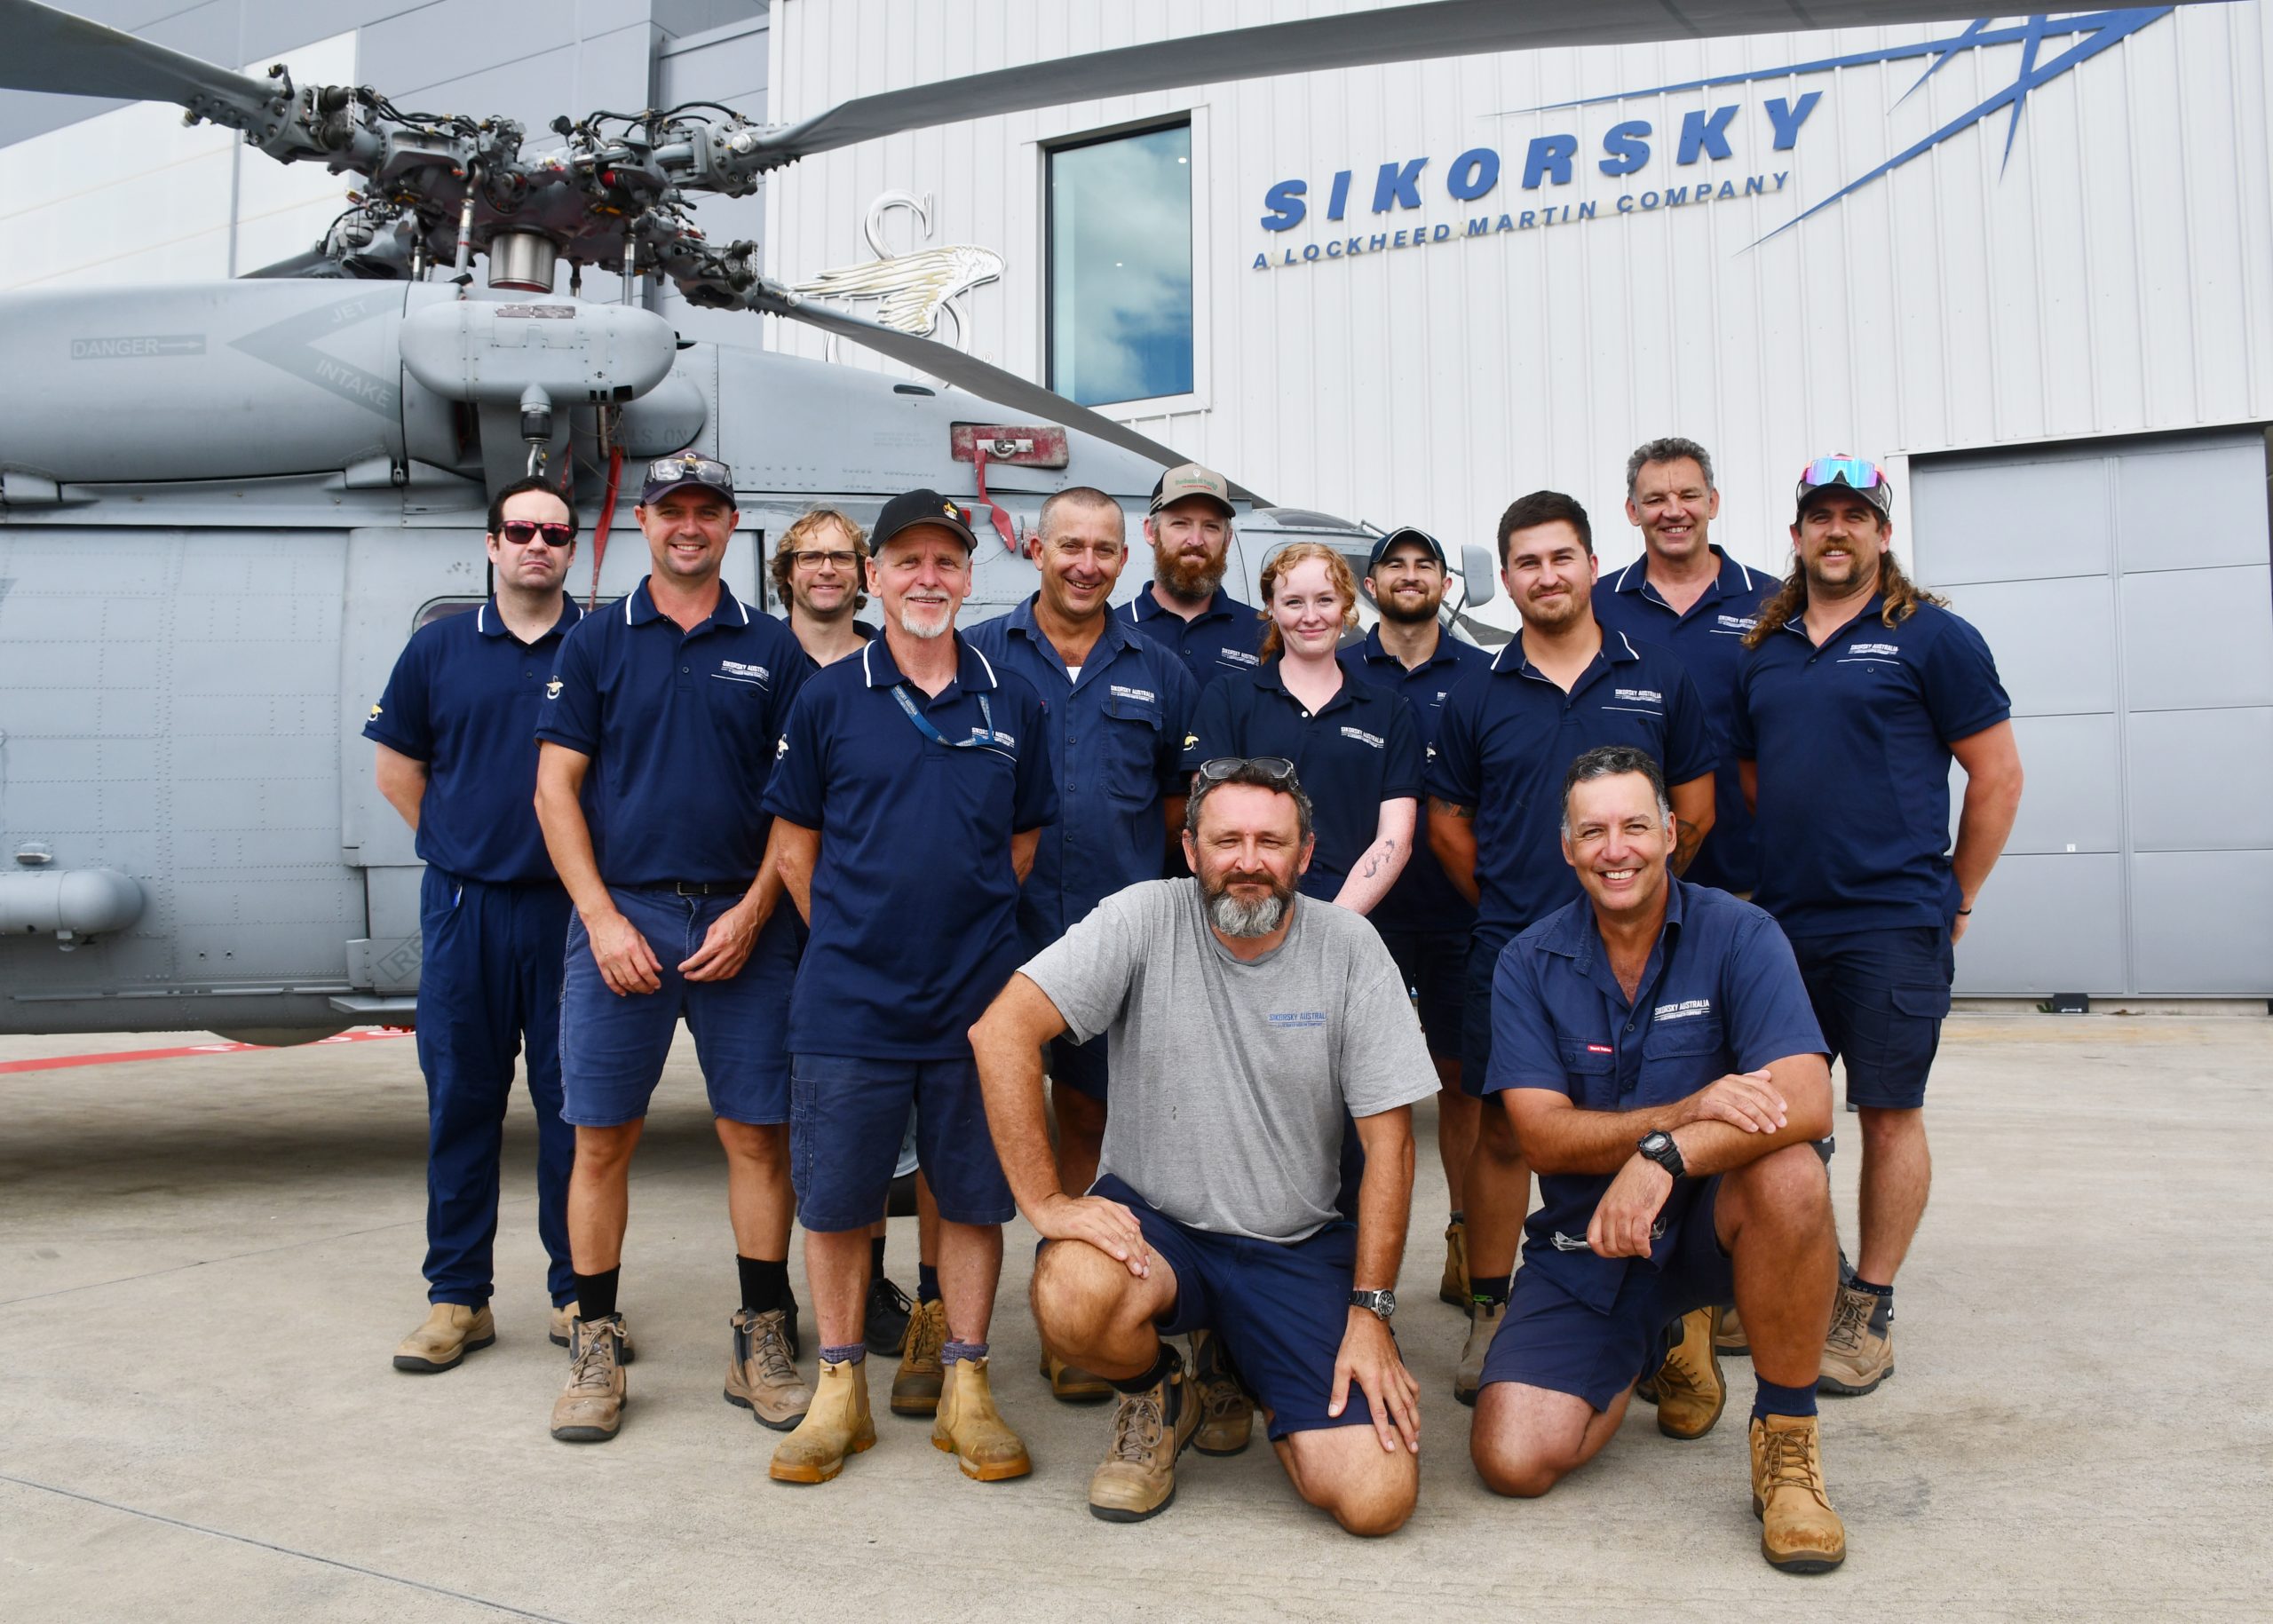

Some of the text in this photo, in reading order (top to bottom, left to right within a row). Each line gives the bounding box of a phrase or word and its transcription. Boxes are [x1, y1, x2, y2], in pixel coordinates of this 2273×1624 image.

[1260, 91, 1823, 234] SIKORSKY
[1252, 170, 1790, 270] A LOCKHEED MARTIN COMPANY
[331, 299, 368, 324] JET
[73, 338, 160, 358] DANGER
[314, 358, 394, 409] INTAKE
[1654, 1003, 1679, 1016] SIKORSKY
[1679, 998, 1710, 1010] AUSTRALIA
